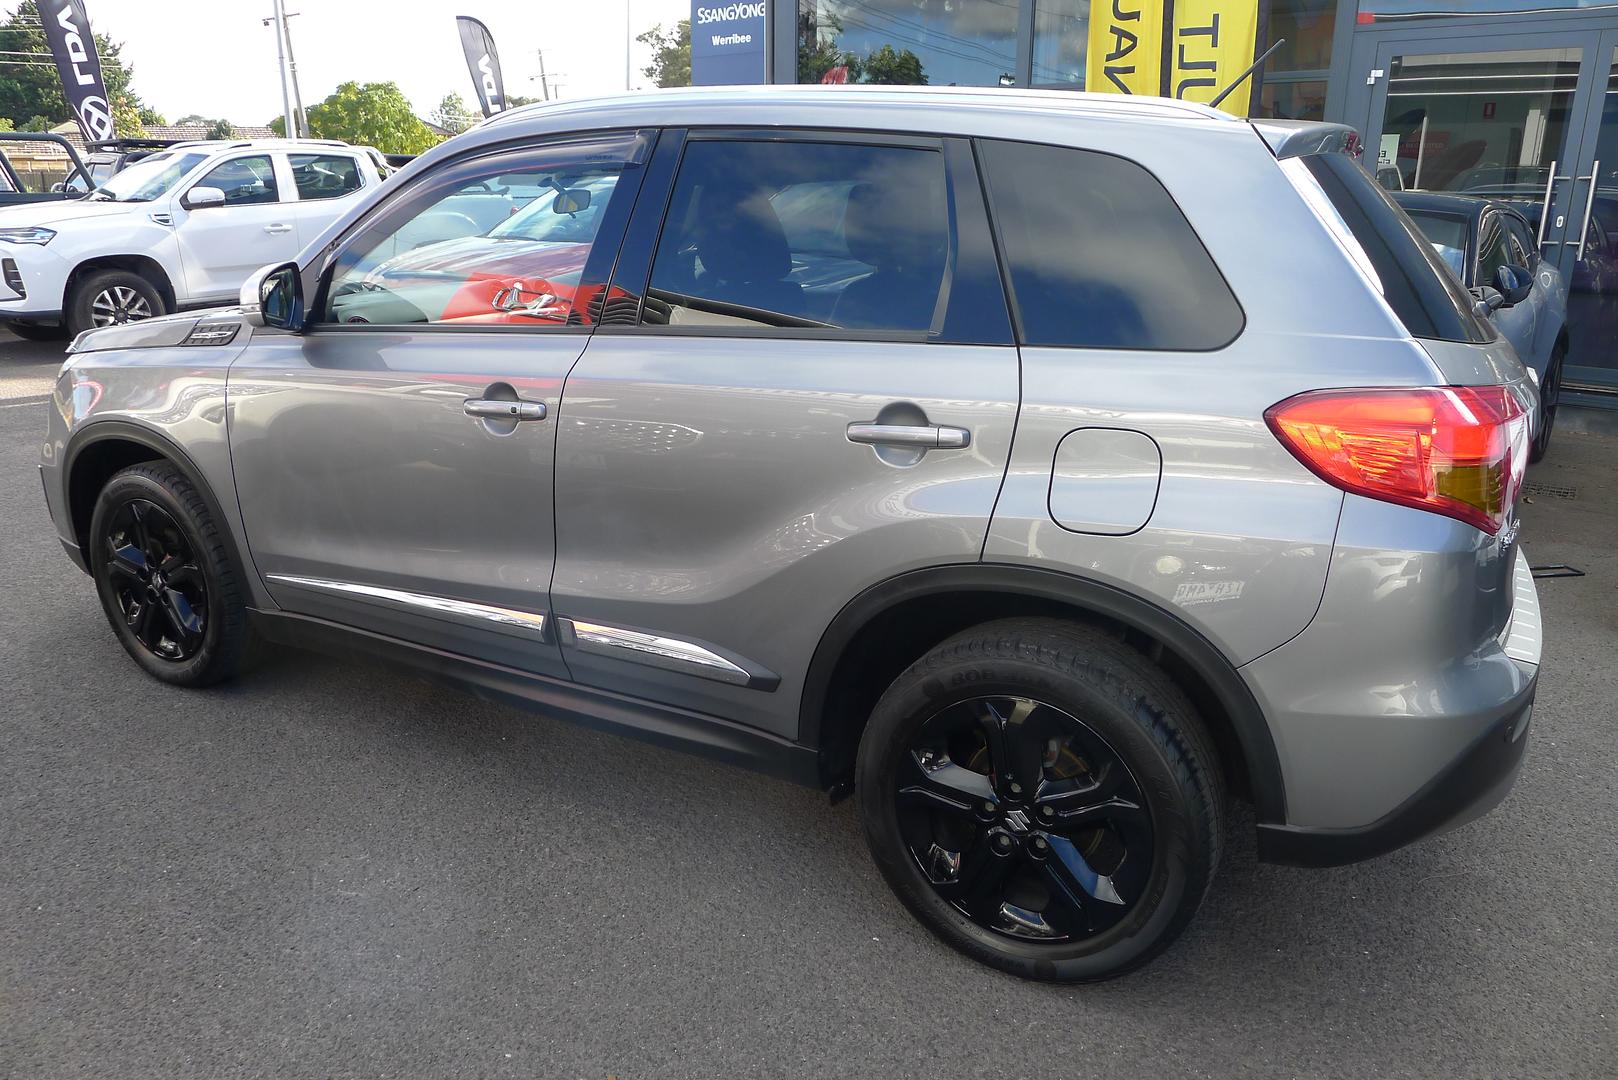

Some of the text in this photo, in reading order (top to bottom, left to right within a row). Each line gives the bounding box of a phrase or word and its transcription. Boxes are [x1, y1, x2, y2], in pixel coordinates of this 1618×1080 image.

[697, 2, 765, 24] SSANGYONG
[57, 4, 95, 86] LDV
[711, 34, 752, 46] Werribee
[478, 53, 502, 113] LDV
